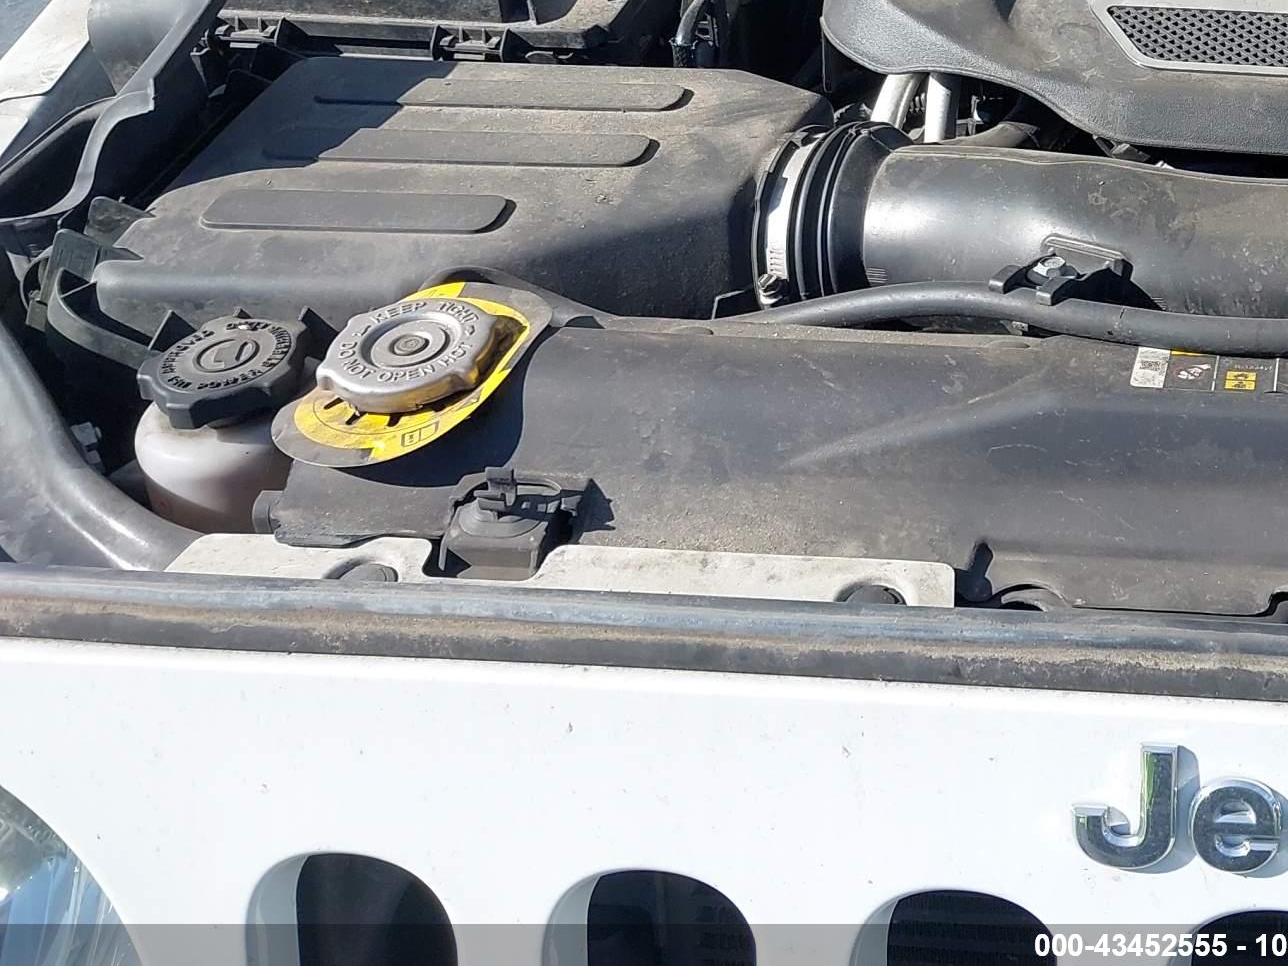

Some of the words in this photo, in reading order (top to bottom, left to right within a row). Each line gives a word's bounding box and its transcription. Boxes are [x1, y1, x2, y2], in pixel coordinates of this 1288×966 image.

[371, 302, 427, 324] KEEP
[439, 301, 480, 323] TIGHT
[339, 343, 354, 359] DO
[440, 342, 473, 367] HOT
[344, 358, 376, 380] NOT
[378, 365, 435, 383] OPEN
